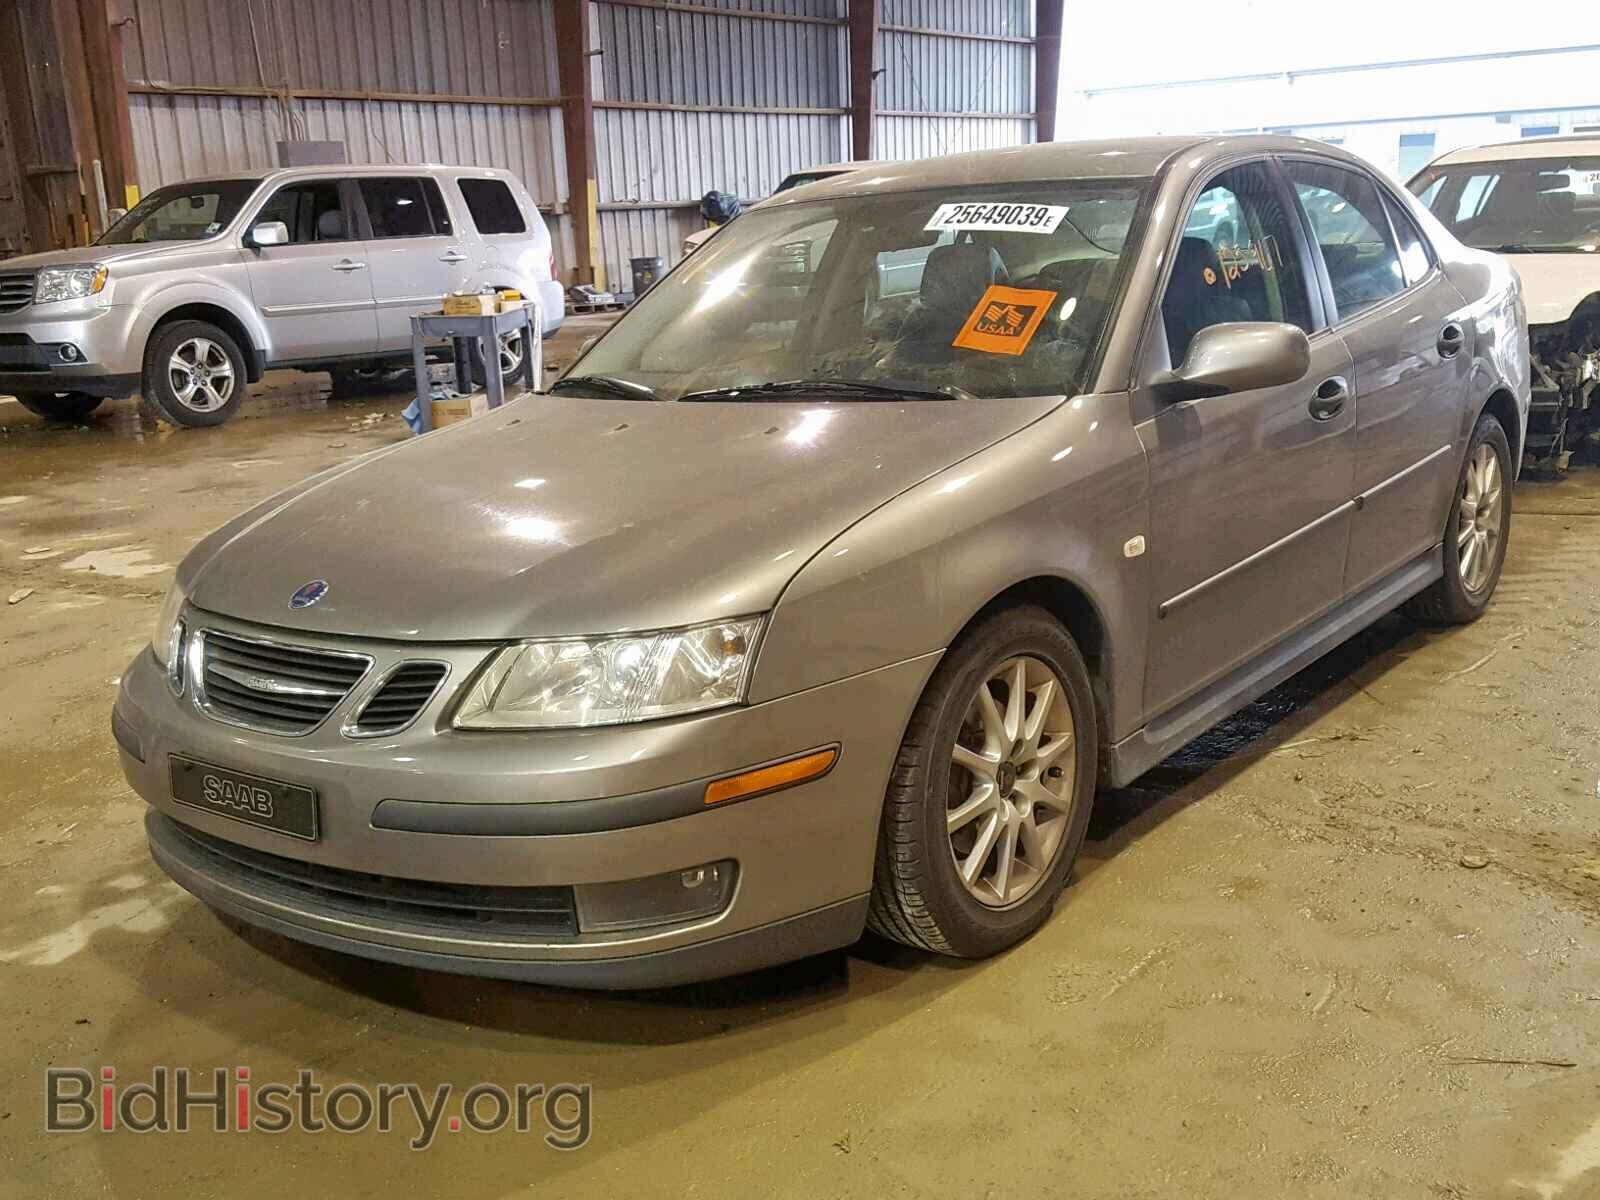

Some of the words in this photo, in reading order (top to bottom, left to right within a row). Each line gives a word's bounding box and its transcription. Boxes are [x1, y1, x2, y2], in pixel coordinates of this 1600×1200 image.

[943, 204, 1050, 227] 25649039
[976, 321, 1015, 336] USAA
[203, 774, 273, 818] SAAB
